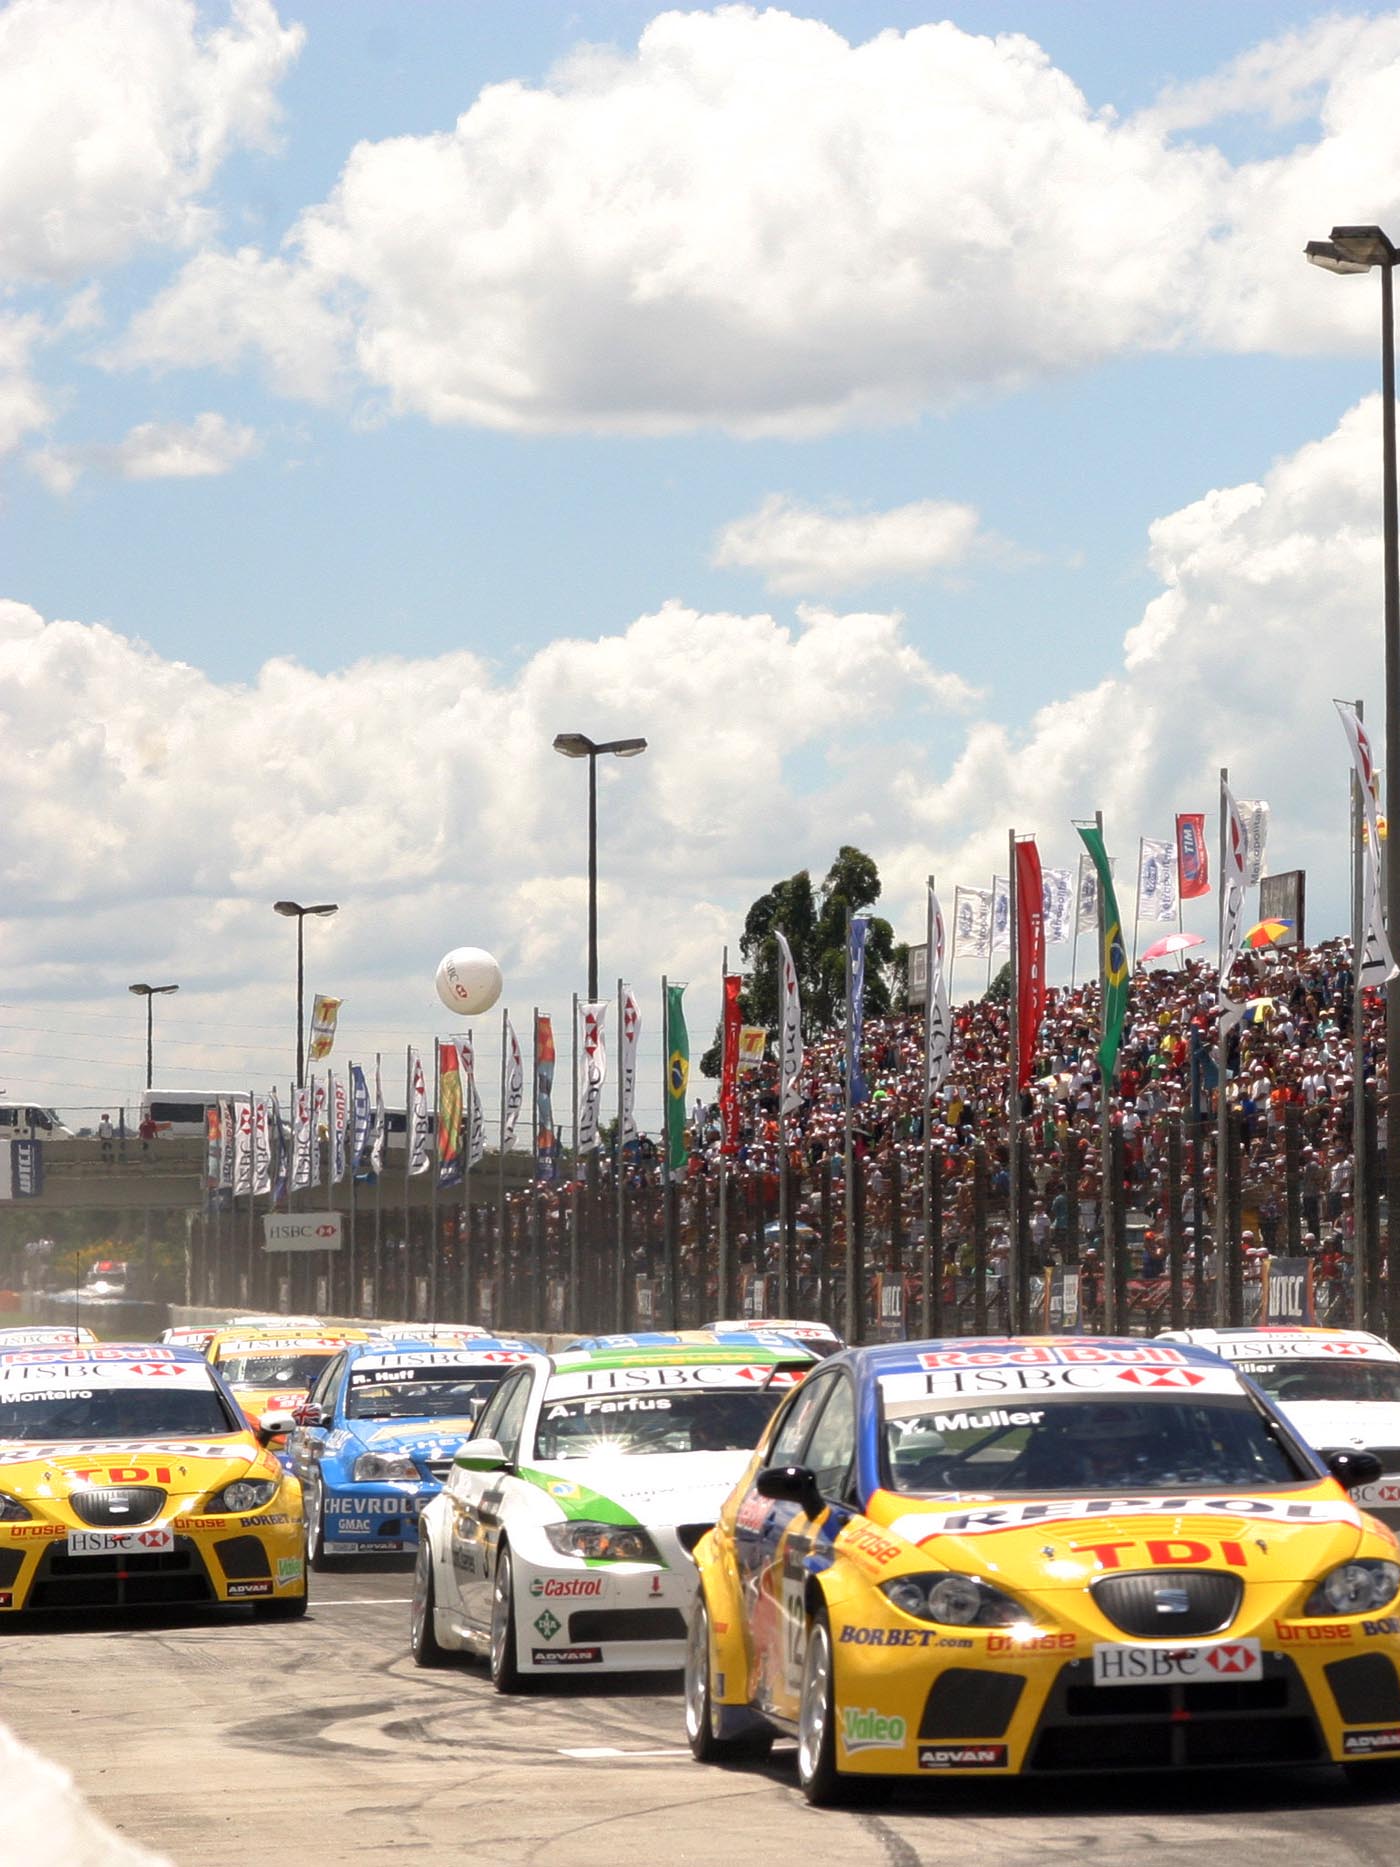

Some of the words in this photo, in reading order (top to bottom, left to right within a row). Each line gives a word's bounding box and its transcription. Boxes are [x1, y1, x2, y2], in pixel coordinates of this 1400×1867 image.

[1183, 829, 1194, 855] TIM
[746, 1033, 762, 1052] T
[412, 1102, 428, 1168] HSBC
[294, 1130, 310, 1185] HSBC
[269, 1225, 312, 1238] HSBC
[5, 1350, 86, 1364] Red
[95, 1348, 173, 1361] Bull
[381, 1353, 476, 1366] HSBC
[921, 1349, 1049, 1368] Red
[1066, 1348, 1183, 1364] Bull
[1217, 1343, 1312, 1357] HSBC
[4, 1363, 118, 1380] HSBC
[352, 1374, 371, 1385] R.
[375, 1370, 414, 1381] Huff
[586, 1367, 724, 1390] HSBC
[925, 1368, 1101, 1395] HSBC
[0, 1389, 93, 1403] Monteiro
[547, 1404, 576, 1420] A.
[584, 1397, 672, 1414] Farfus
[894, 1418, 926, 1435] Y.
[936, 1409, 1045, 1432] Muller
[73, 1467, 171, 1484] TDI
[1350, 1486, 1375, 1502] BC
[324, 1498, 431, 1514] CHEVROLE
[943, 1499, 1329, 1530] REPSOL
[11, 1524, 66, 1537] brose
[174, 1517, 226, 1529] brose
[338, 1518, 370, 1531] GMAC
[71, 1532, 136, 1552] HSBC
[847, 1522, 901, 1565] brose
[1072, 1540, 1248, 1568] TDI
[228, 1584, 269, 1594] ADVAN
[544, 1578, 602, 1597] Castrol
[839, 1625, 973, 1648] BORBET.com
[1274, 1620, 1352, 1641] brose
[534, 1651, 593, 1661] ADVAN
[1100, 1649, 1200, 1678] HSBC
[845, 1708, 904, 1741] Valeo
[921, 1751, 996, 1762] ADVAN
